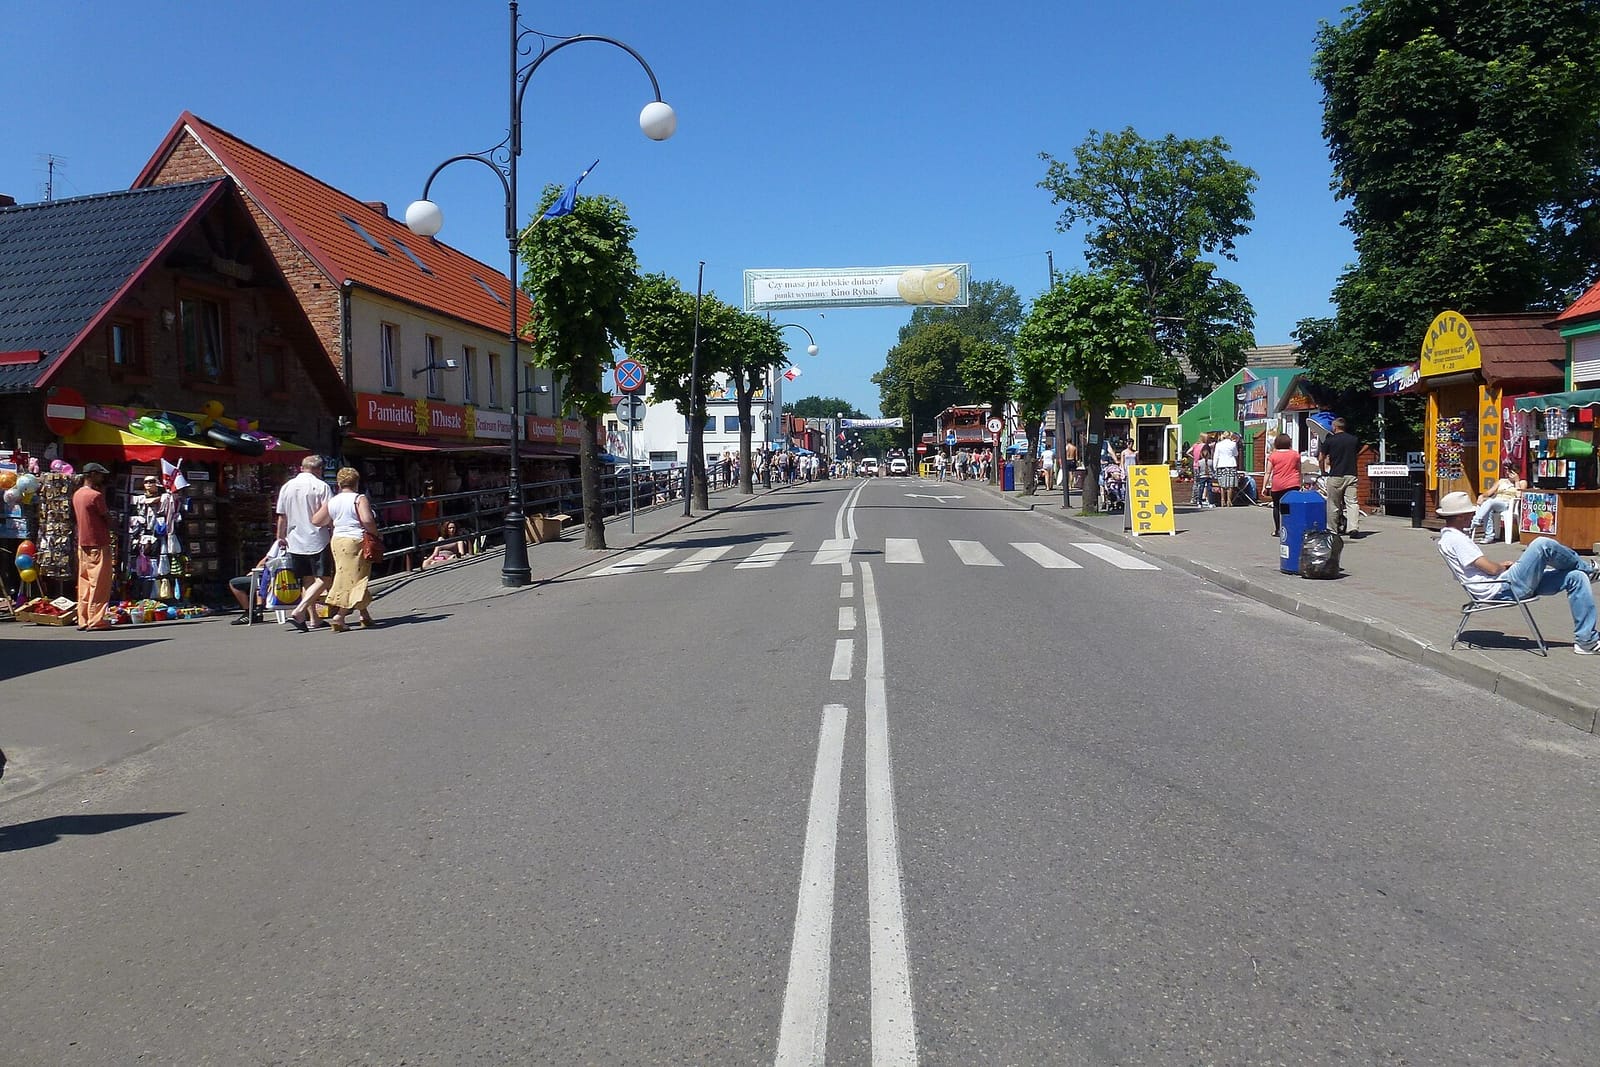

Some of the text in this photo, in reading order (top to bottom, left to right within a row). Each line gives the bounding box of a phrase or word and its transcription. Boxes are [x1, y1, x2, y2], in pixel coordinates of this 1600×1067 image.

[768, 280, 782, 290] Czy
[851, 277, 884, 287] dukaty?
[774, 291, 794, 300] punkt
[831, 288, 850, 297] Kino
[852, 287, 878, 297] Rybak
[1423, 315, 1475, 363] KANTOR
[368, 400, 414, 426] Pamiątki
[1112, 402, 1164, 418] wiaty
[1135, 467, 1152, 530] KANTOR
